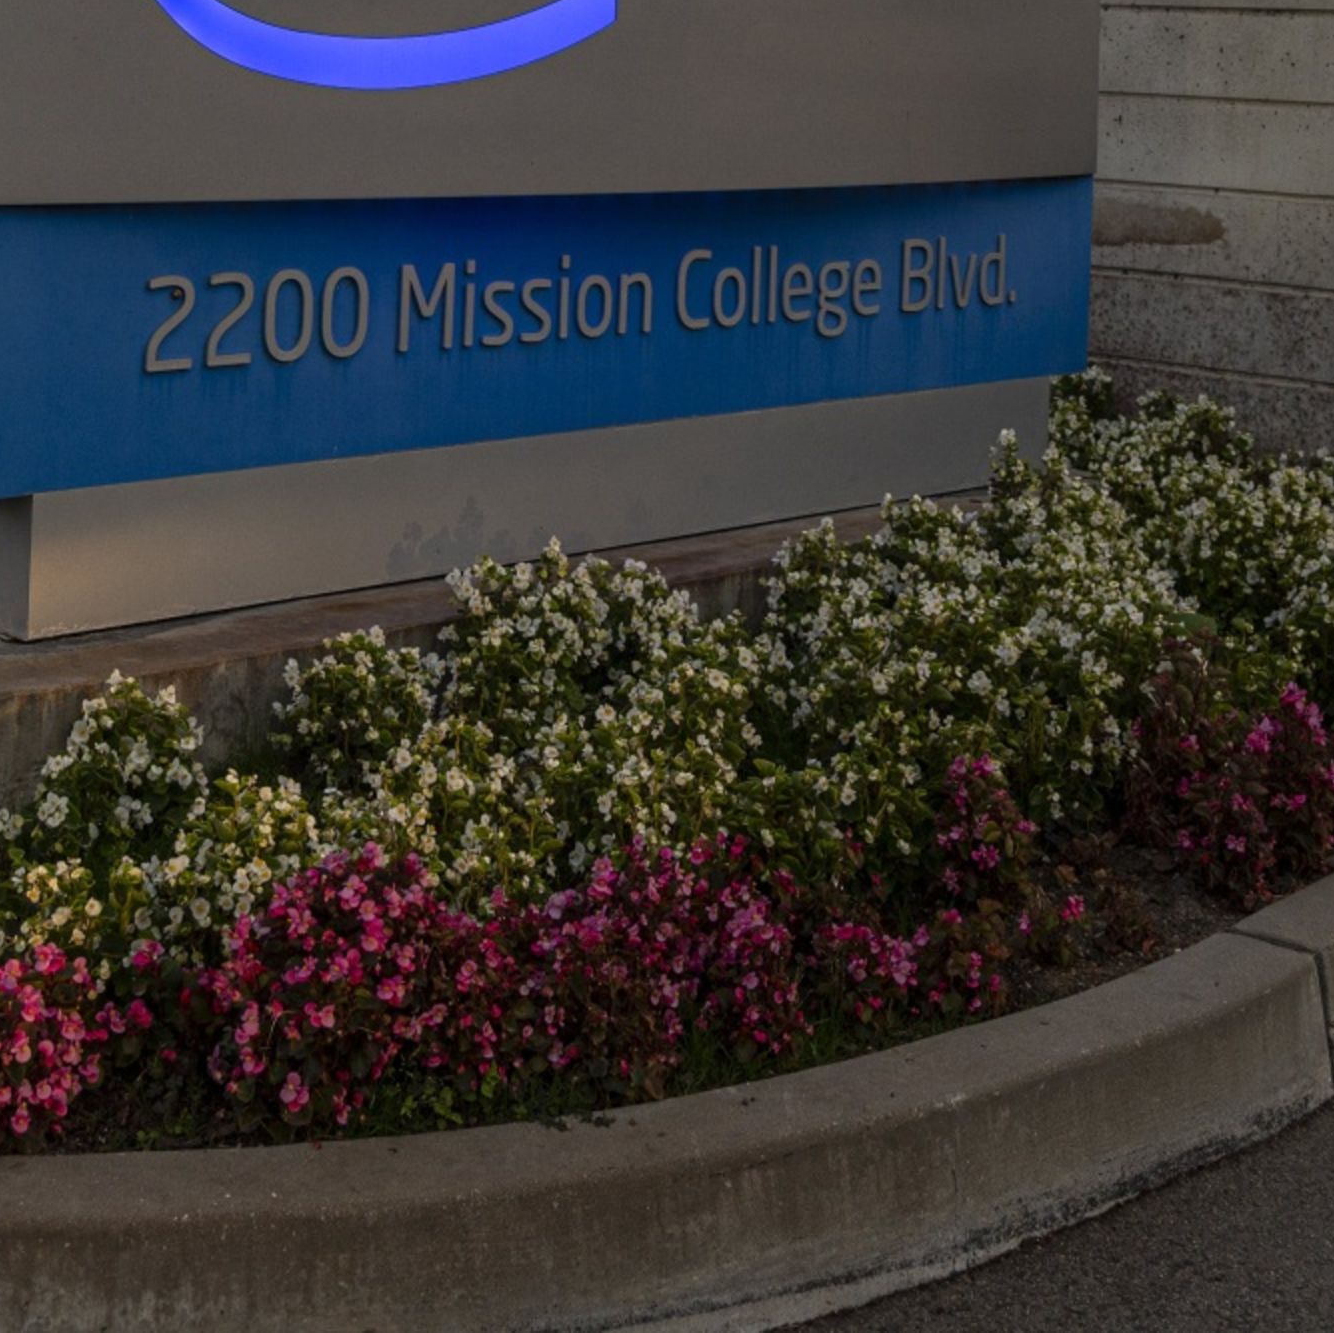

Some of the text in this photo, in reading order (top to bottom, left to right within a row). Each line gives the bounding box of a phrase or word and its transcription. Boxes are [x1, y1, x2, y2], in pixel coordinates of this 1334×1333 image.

[144, 234, 1017, 372] 2200 Mission College Blvd.
